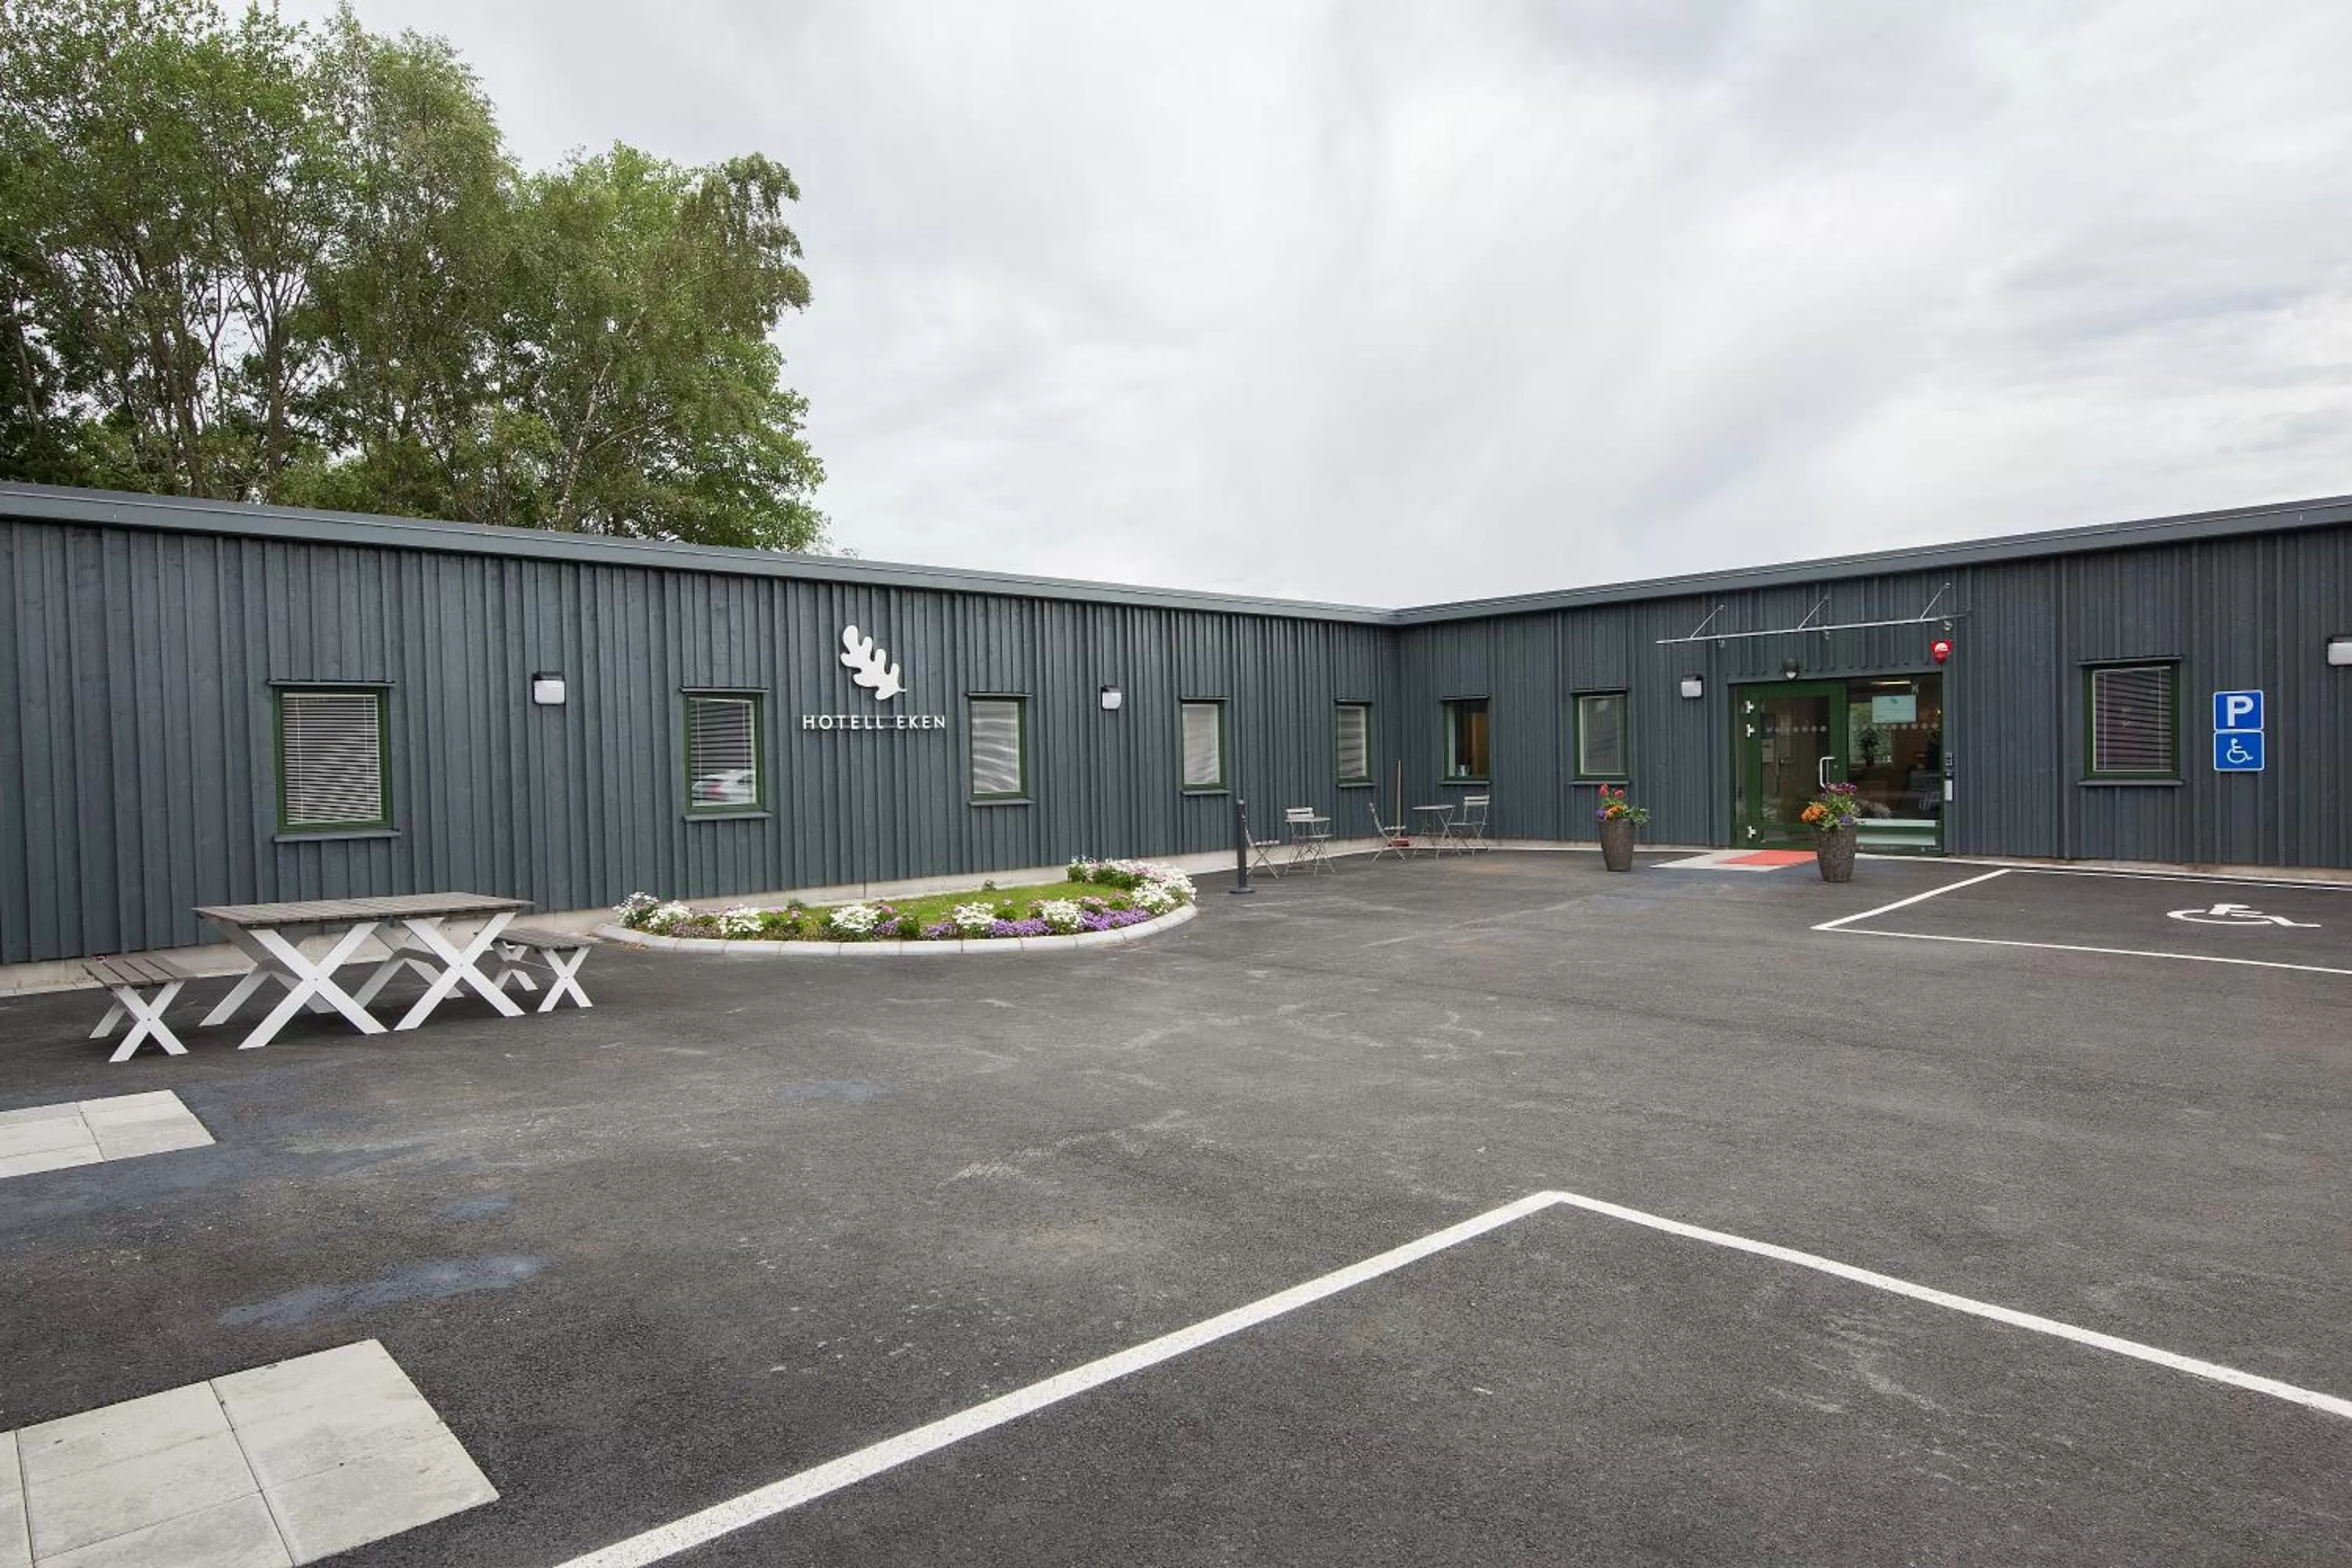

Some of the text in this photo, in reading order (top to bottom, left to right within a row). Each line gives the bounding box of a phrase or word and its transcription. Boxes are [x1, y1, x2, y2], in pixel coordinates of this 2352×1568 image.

[802, 715, 946, 729] HOTELL EKEN
[2227, 695, 2253, 727] P
